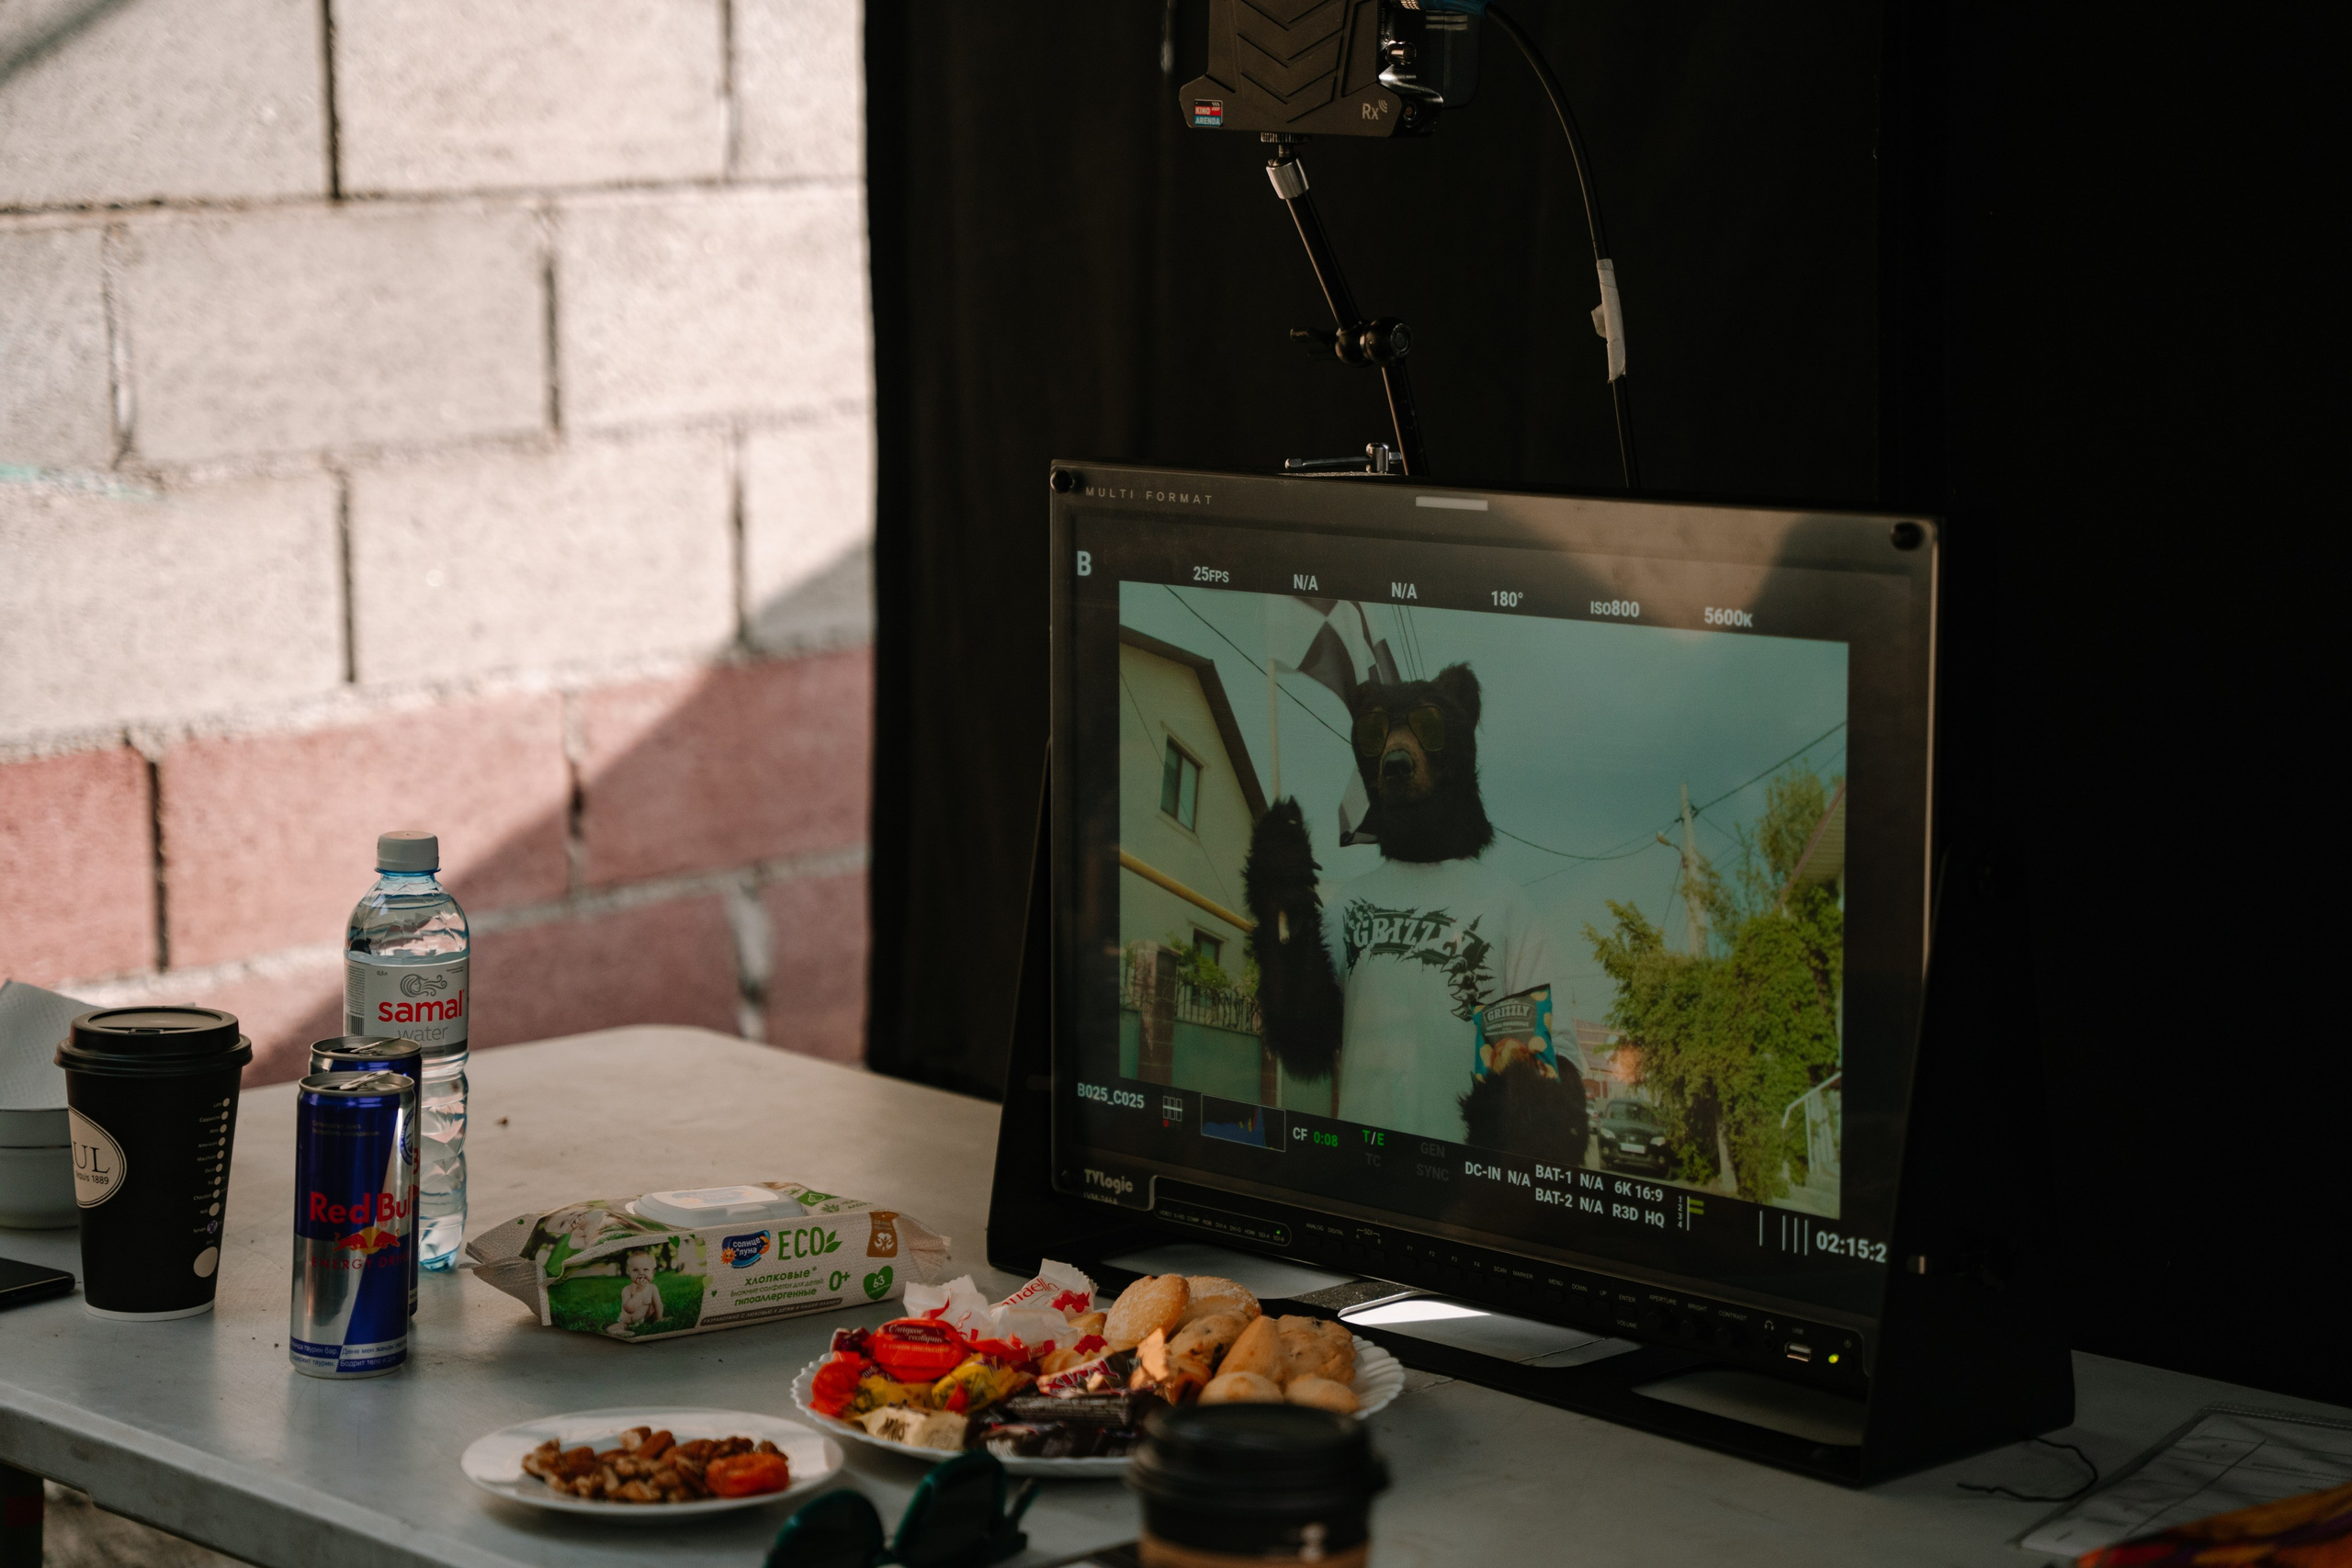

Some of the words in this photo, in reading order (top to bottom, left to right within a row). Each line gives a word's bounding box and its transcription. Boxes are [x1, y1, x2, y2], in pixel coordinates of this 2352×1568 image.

[1195, 107, 1210, 115] KINO
[1195, 117, 1220, 125] ARENDA
[1086, 488, 1135, 500] MULTI
[1146, 491, 1213, 504] FORMAT
[1077, 551, 1091, 576] B
[1193, 566, 1229, 583] 25FPS
[1293, 574, 1318, 591] N/A
[1391, 582, 1418, 600] N/A
[1491, 591, 1523, 607] 180°
[1590, 600, 1640, 618] ISO800
[1353, 918, 1475, 957] GRIZZLY
[378, 989, 462, 1022] samal
[1487, 1005, 1531, 1021] GRIZZLY
[398, 1026, 448, 1042] water
[1077, 1082, 1145, 1110] B025_C025
[1293, 1127, 1307, 1141] CF
[1313, 1131, 1339, 1147] 0:08
[1362, 1130, 1385, 1146] T/E
[73, 1141, 110, 1173] UL
[1420, 1142, 1445, 1158] GEN
[92, 1175, 109, 1185] 1889
[1416, 1164, 1449, 1181] SYNC
[1464, 1161, 1500, 1181] DC-IN
[1508, 1169, 1532, 1187] N/A
[1535, 1164, 1572, 1185] BAT-1
[1580, 1173, 1604, 1190] N/A
[1614, 1180, 1632, 1197] 6K
[1635, 1185, 1664, 1202] 16:9
[310, 1191, 371, 1224] Red
[376, 1185, 412, 1222] Bul
[1535, 1187, 1573, 1208] BAT-2
[1580, 1196, 1604, 1214] N/A
[1612, 1203, 1639, 1222] R3D
[1645, 1210, 1665, 1229] HQ
[1306, 1223, 1324, 1232] ANALOG
[1327, 1226, 1344, 1235] DIGITAL
[732, 1236, 762, 1247] солнце
[778, 1226, 825, 1260] ECO
[739, 1247, 758, 1257] луна
[311, 1256, 373, 1269] ENERGY
[830, 1270, 851, 1292] 0+
[873, 1275, 885, 1288] 63
[735, 1288, 817, 1306] гипоаллергенные
[1493, 1266, 1507, 1275] SCAN
[1512, 1270, 1533, 1280] MARKER
[1548, 1278, 1563, 1287] MENU
[1571, 1283, 1588, 1292] DOWN
[1618, 1293, 1636, 1303] ENTER
[1649, 1294, 1678, 1306] APERTURE
[1718, 1309, 1747, 1321] CONTRAST
[1616, 1319, 1639, 1330] VOLUME
[340, 1359, 366, 1370] Бодрит
[367, 1358, 381, 1366] тело
